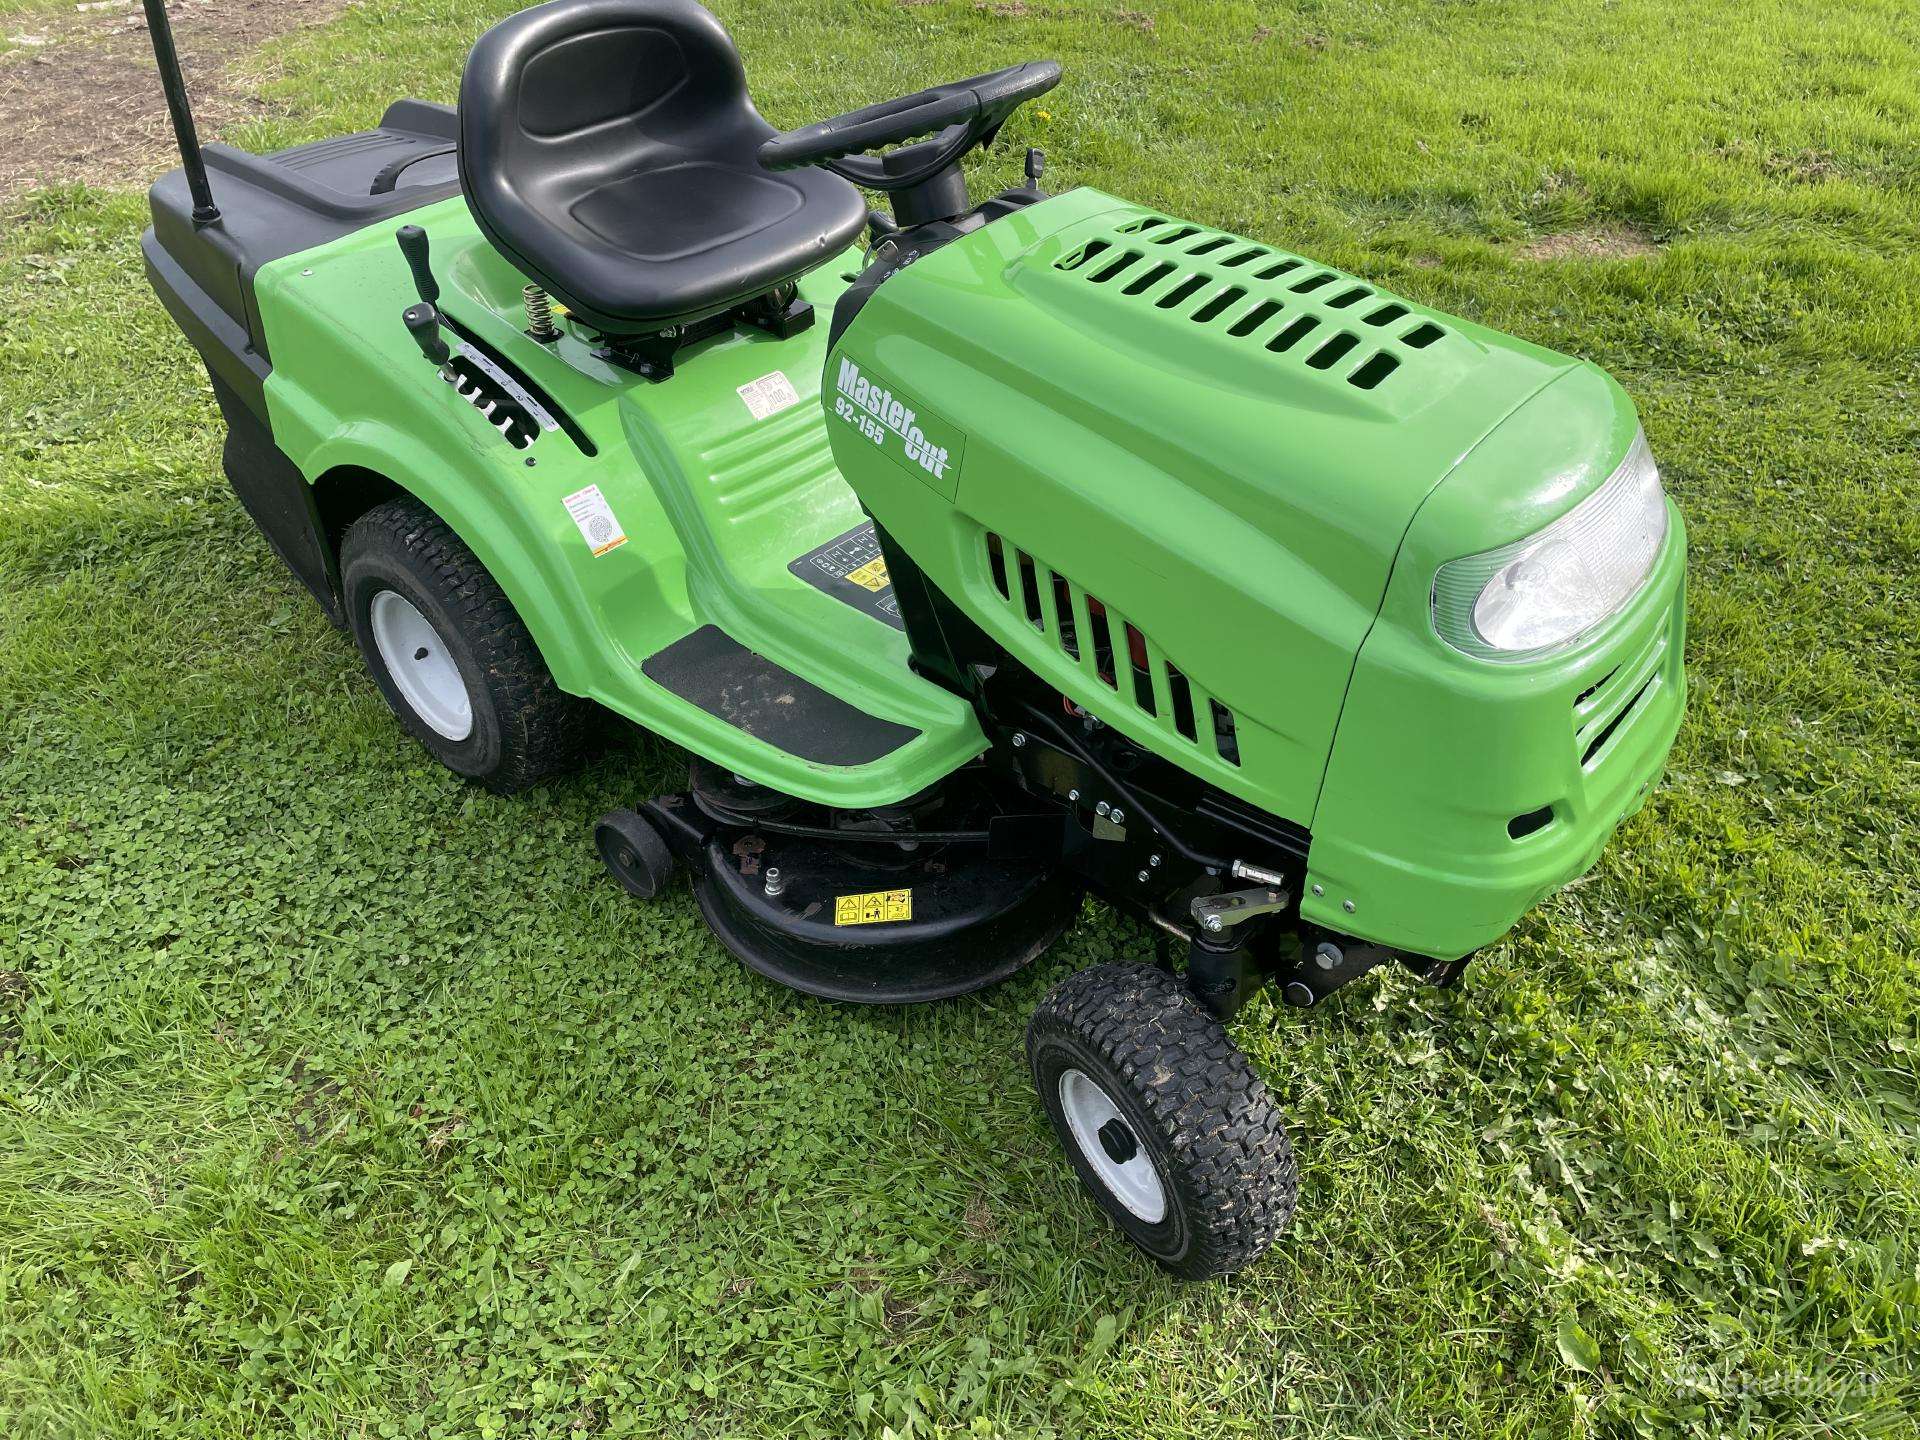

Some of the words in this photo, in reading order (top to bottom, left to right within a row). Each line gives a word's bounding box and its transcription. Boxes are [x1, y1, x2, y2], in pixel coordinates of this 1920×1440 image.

[835, 396, 885, 445] 92-155
[837, 356, 916, 435] Master
[904, 426, 949, 480] Cut
